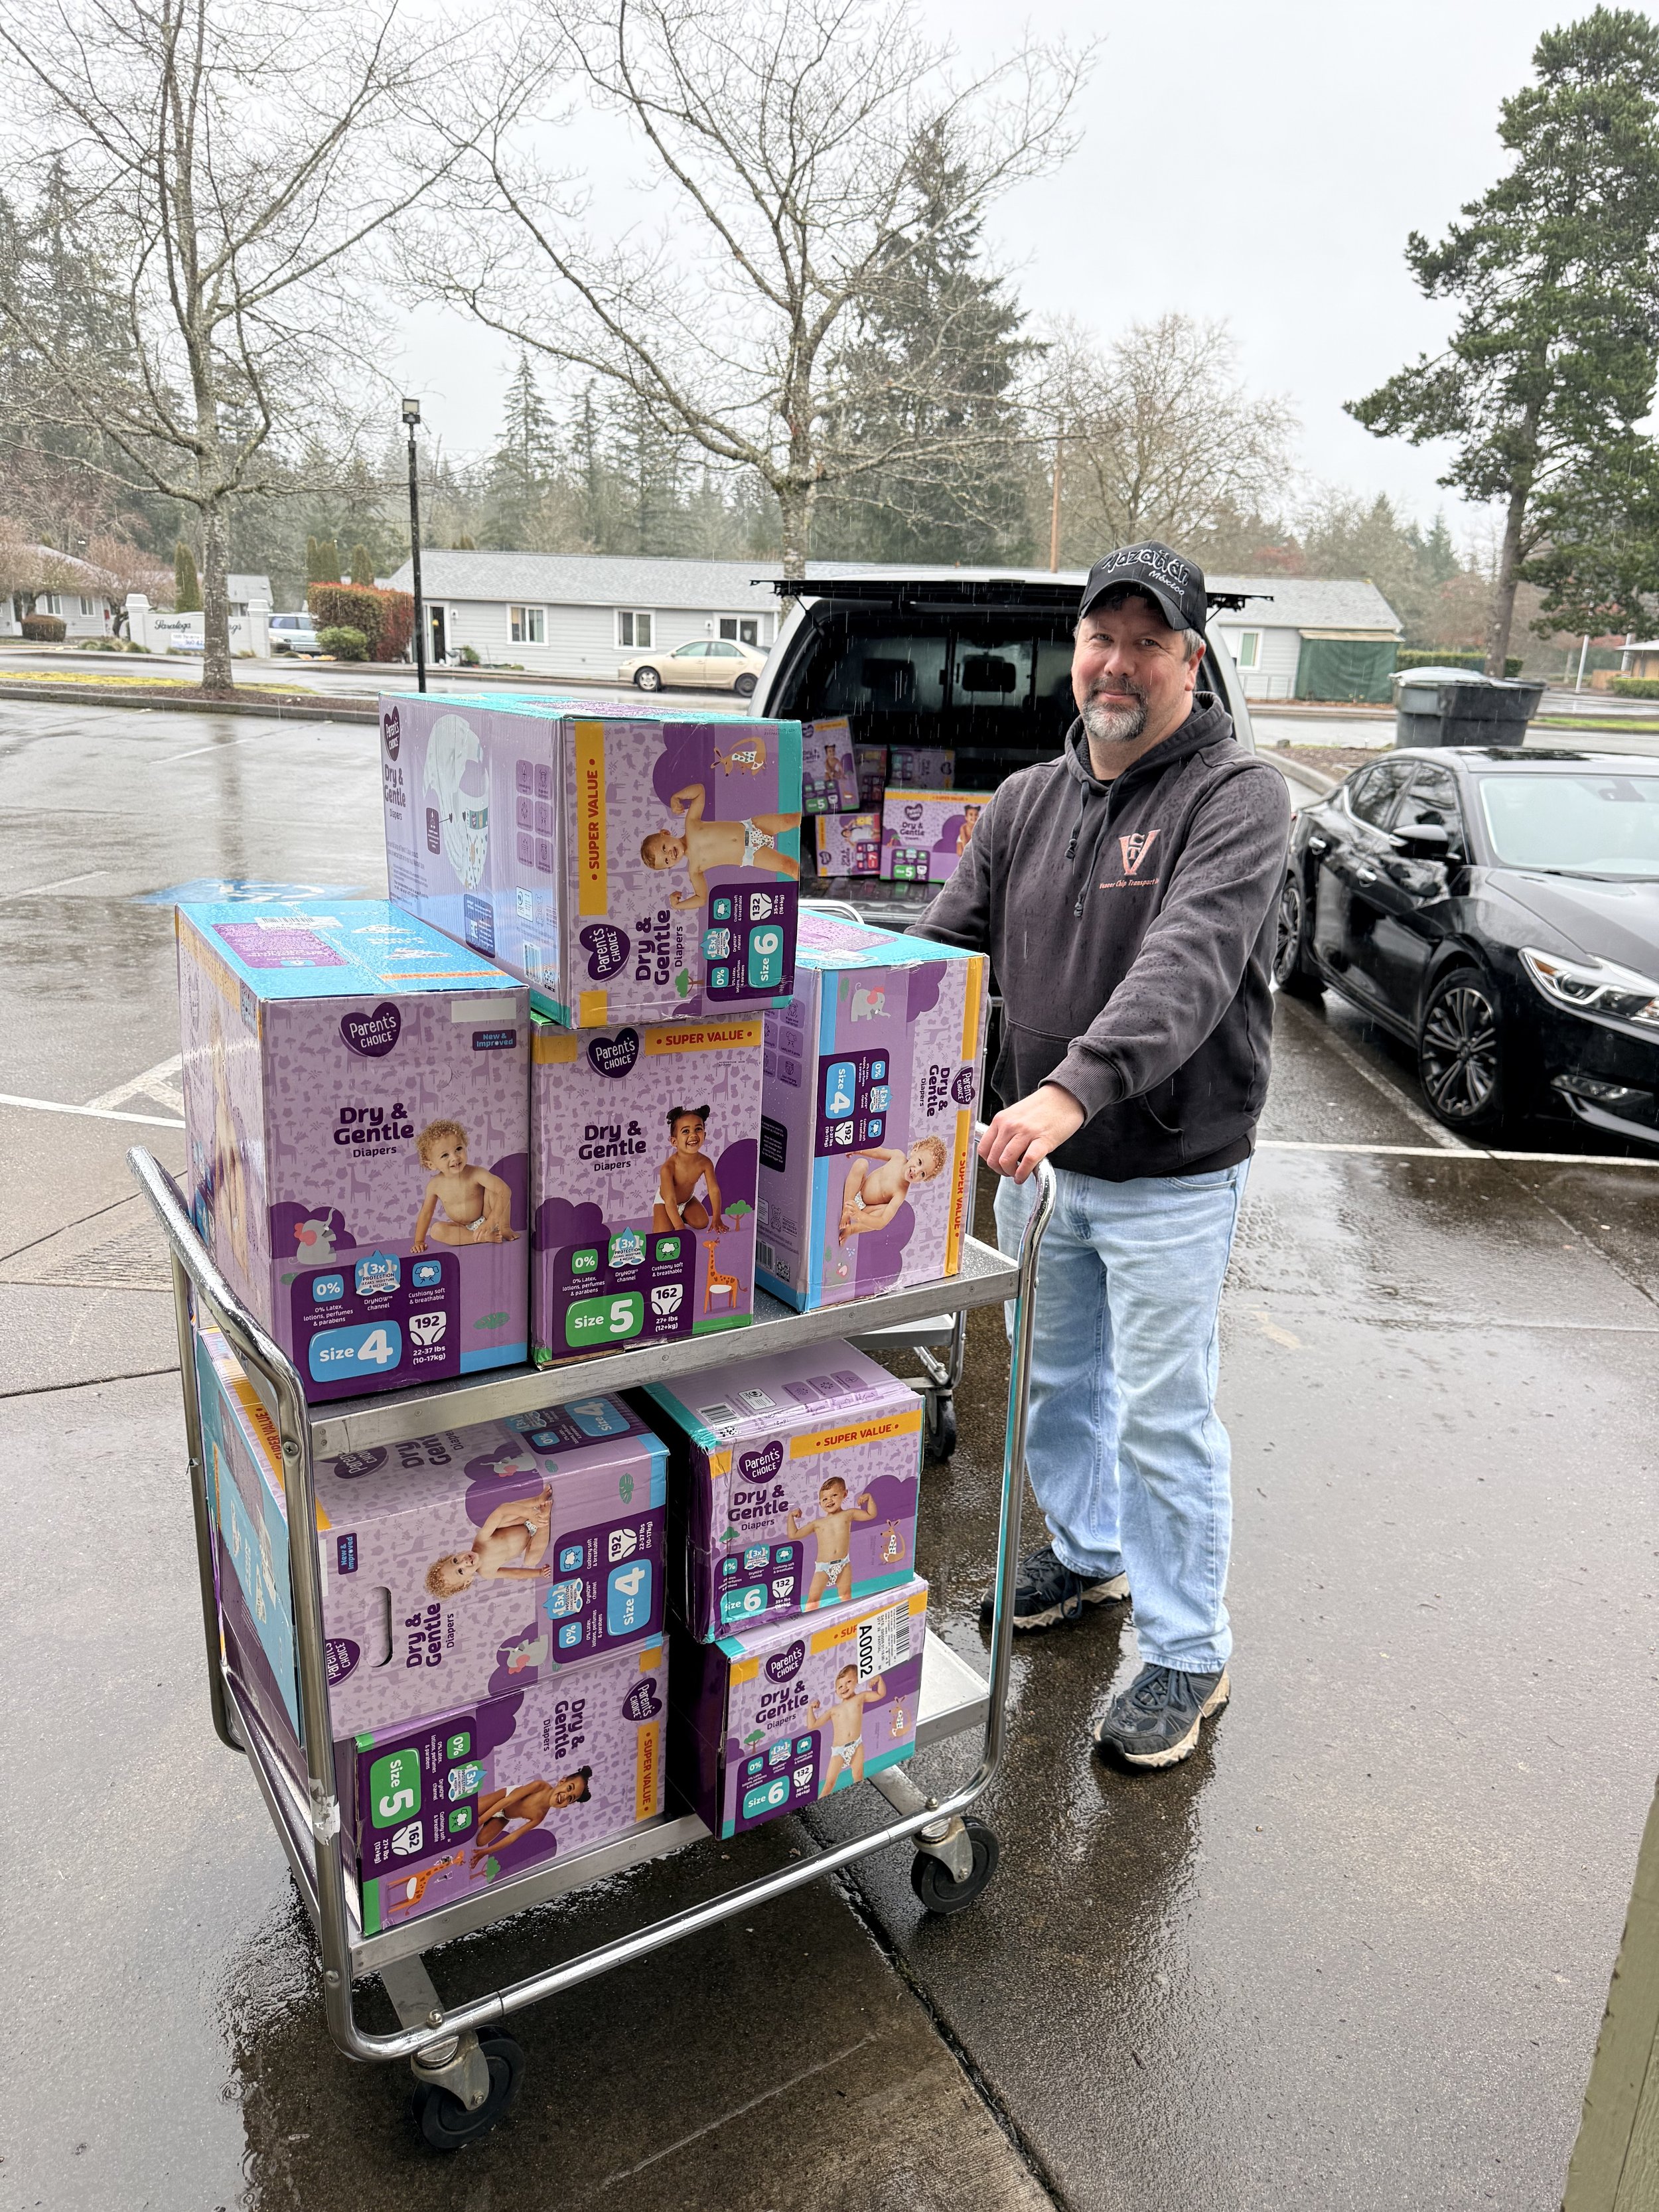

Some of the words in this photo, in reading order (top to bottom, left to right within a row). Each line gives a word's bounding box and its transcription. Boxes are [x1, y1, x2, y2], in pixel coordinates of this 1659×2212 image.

[385, 764, 396, 788] Dry
[398, 768, 403, 786] &
[384, 784, 405, 807] Gentle
[587, 770, 599, 818] VALUE
[818, 799, 825, 809] 5
[589, 822, 599, 869] SUPER
[906, 867, 912, 877] 5
[636, 917, 651, 933] &
[589, 928, 611, 973] Parent's
[607, 930, 621, 962] CHOICE
[654, 910, 670, 986] Gentle
[674, 926, 684, 967] Diapers
[754, 933, 778, 954] 6
[636, 940, 655, 981] Dry
[760, 958, 769, 982] Size
[717, 970, 725, 986] 0%
[349, 1012, 396, 1039] Parent's
[360, 1031, 393, 1048] CHOICE
[476, 1039, 514, 1047] Improved
[595, 1037, 635, 1061] Parent's
[665, 1033, 703, 1046] SUPER
[707, 1030, 744, 1042] VALUE
[604, 1054, 632, 1070] CHOICE
[875, 1063, 881, 1077] 0%
[927, 1065, 939, 1117] Gentle
[937, 1067, 950, 1096] Dry
[830, 1091, 851, 1114] 4
[938, 1100, 948, 1111] &
[340, 1106, 384, 1126] Dry
[391, 1103, 407, 1120] &
[334, 1122, 414, 1145] Gentle
[584, 1125, 621, 1143] Dry
[627, 1120, 642, 1136] &
[353, 1146, 397, 1158] Diapers
[579, 1138, 646, 1160] Gentle
[594, 1161, 631, 1171] Diapers
[957, 1160, 966, 1194] SUPER
[954, 1197, 963, 1230] VALUE
[621, 1238, 634, 1248] 3x
[370, 1263, 386, 1274] 3x
[575, 1256, 595, 1268] 0%
[317, 1282, 340, 1295] 0%
[408, 1290, 433, 1298] Cushiony
[414, 1294, 445, 1303] breathable
[575, 1287, 599, 1295] parabens
[656, 1288, 677, 1299] 162
[319, 1317, 346, 1326] parabens
[326, 1309, 354, 1319] perfumes
[415, 1315, 439, 1329] 192
[575, 1315, 604, 1329] Size
[609, 1299, 634, 1333] 5
[656, 1322, 678, 1332] (12+kg)
[319, 1347, 354, 1363] Size
[357, 1329, 394, 1364] 4
[413, 1347, 433, 1357] 22-37
[413, 1353, 446, 1365] (10-17kg)
[573, 1402, 605, 1416] 4
[255, 1412, 275, 1435] VALUE
[595, 1416, 612, 1431] Size
[824, 1432, 857, 1447] SUPER
[859, 1424, 892, 1439] VALUE
[395, 1441, 425, 1469] Dry
[745, 1447, 780, 1471] Parent's
[752, 1463, 777, 1478] CHOICE
[733, 1488, 769, 1507] Dry
[772, 1484, 784, 1499] &
[727, 1499, 789, 1522] Gentle
[741, 1518, 775, 1531] Diapers
[612, 1535, 622, 1557] 192
[614, 1567, 645, 1596] 4
[555, 1593, 565, 1607] 3x
[623, 1598, 634, 1625] Size
[744, 1589, 761, 1611] 6
[405, 1613, 421, 1627] &
[447, 1613, 456, 1648] Diapers
[423, 1603, 442, 1667] Gentle
[566, 1625, 577, 1644] 0%
[335, 1643, 351, 1668] CHOICE
[406, 1632, 426, 1668] Dry
[771, 1647, 802, 1672] Parent's
[859, 1625, 873, 1678] A0002
[776, 1662, 799, 1678] CHOICE
[637, 1684, 656, 1717] Parent's
[760, 1688, 790, 1708] Dry
[794, 1680, 806, 1694] &
[568, 1698, 585, 1732] Dry
[630, 1695, 642, 1718] CHOICE
[755, 1694, 809, 1724] Gentle
[554, 1700, 569, 1760] Gentle
[766, 1713, 796, 1731] Diapers
[453, 1736, 464, 1755] 0%
[542, 1719, 551, 1751] Diapers
[571, 1735, 585, 1749] &
[643, 1739, 652, 1772] SUPER
[750, 1761, 762, 1771] 0%
[390, 1759, 403, 1788] Size
[466, 1771, 476, 1785] 3x
[797, 1767, 809, 1777] 132
[642, 1773, 651, 1805] VALUE
[748, 1796, 766, 1807] Size
[768, 1782, 784, 1804] 6
[379, 1788, 414, 1817] 5
[409, 1826, 419, 1848] 162
